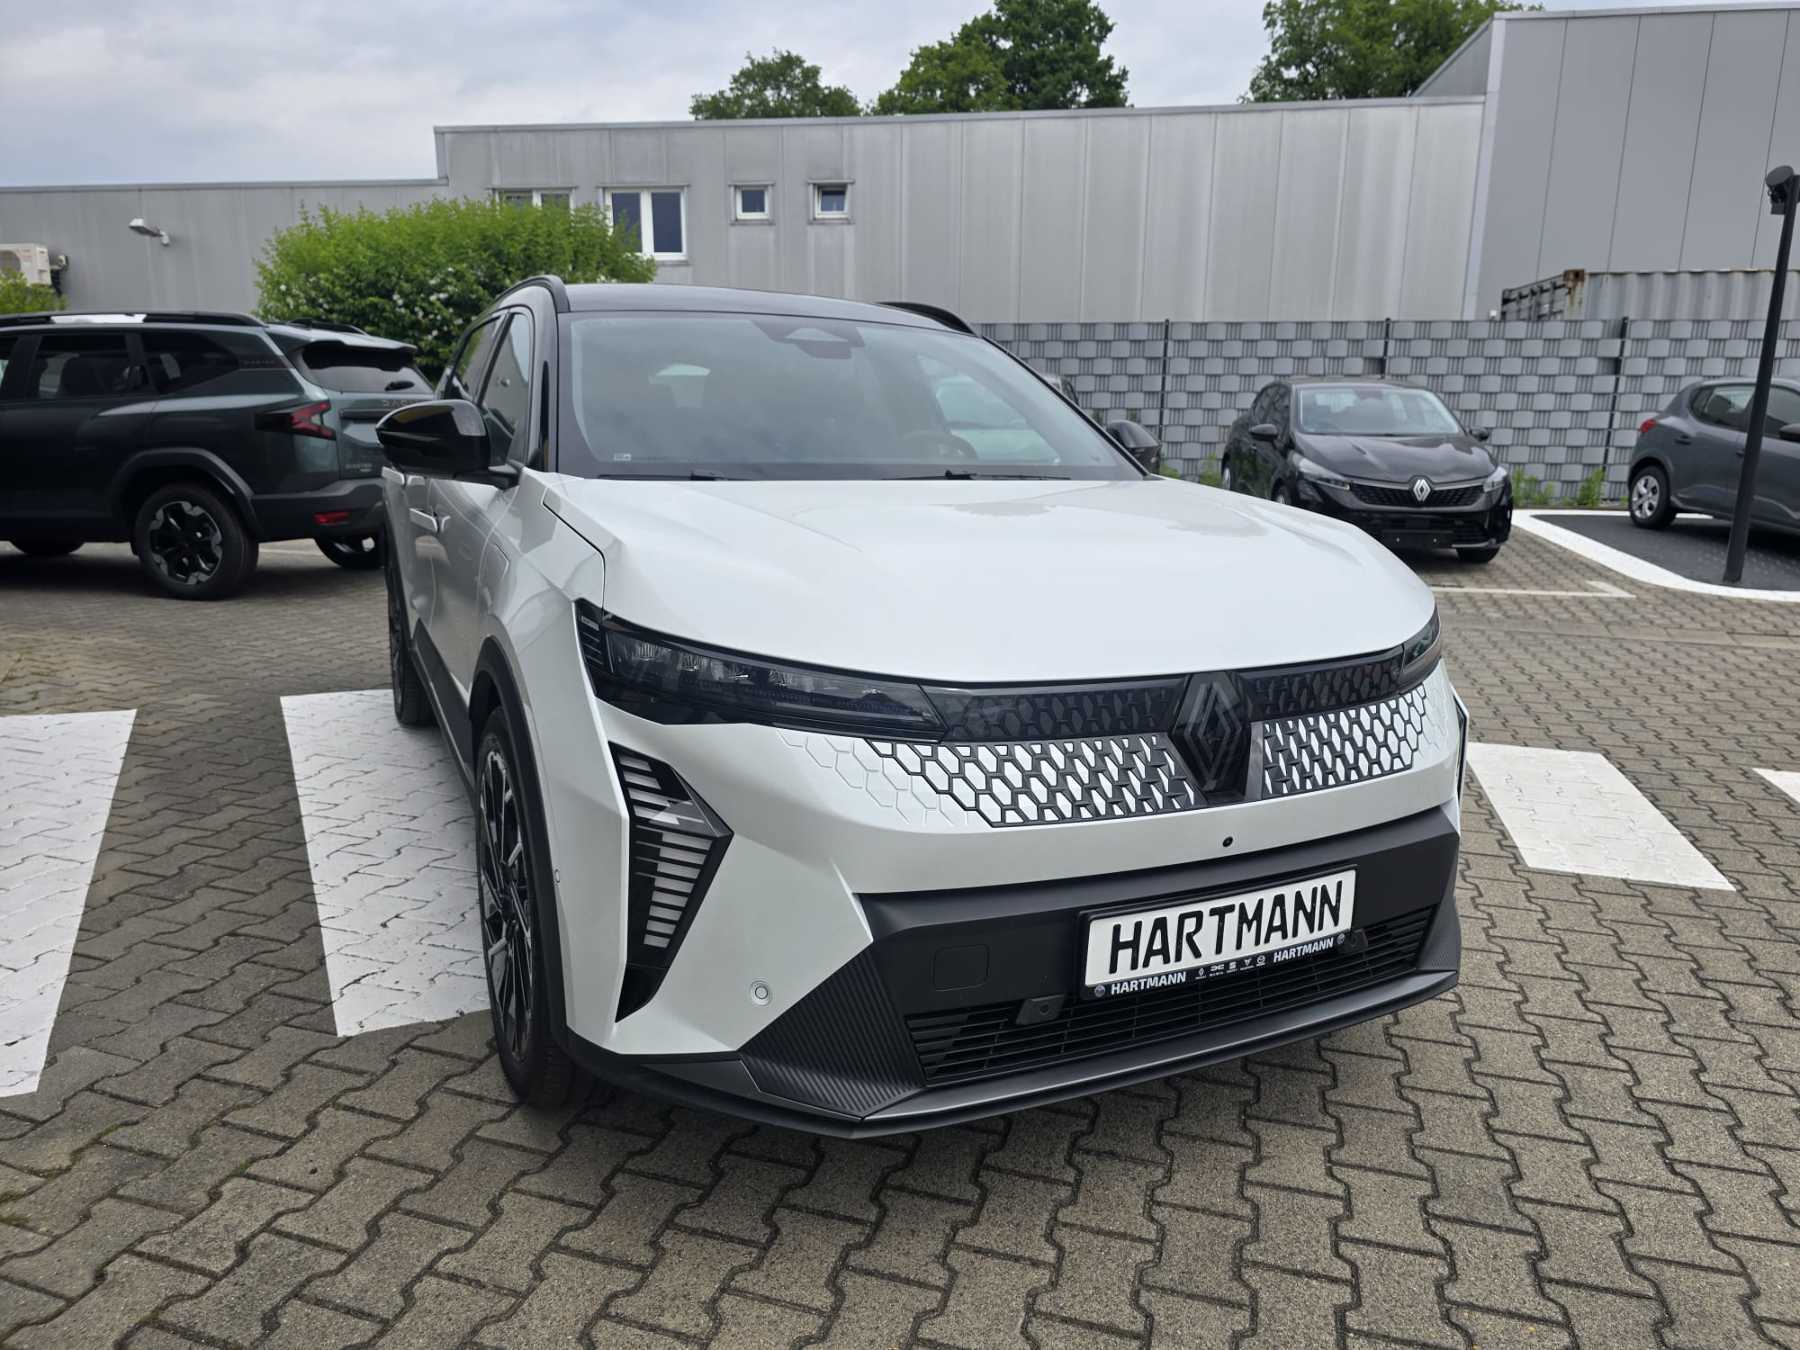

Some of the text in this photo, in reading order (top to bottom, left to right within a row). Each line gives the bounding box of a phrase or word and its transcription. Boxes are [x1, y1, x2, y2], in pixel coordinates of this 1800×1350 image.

[1109, 880, 1343, 975] HARTMANN
[1111, 937, 1334, 996] HARTMANN HARTMANN
